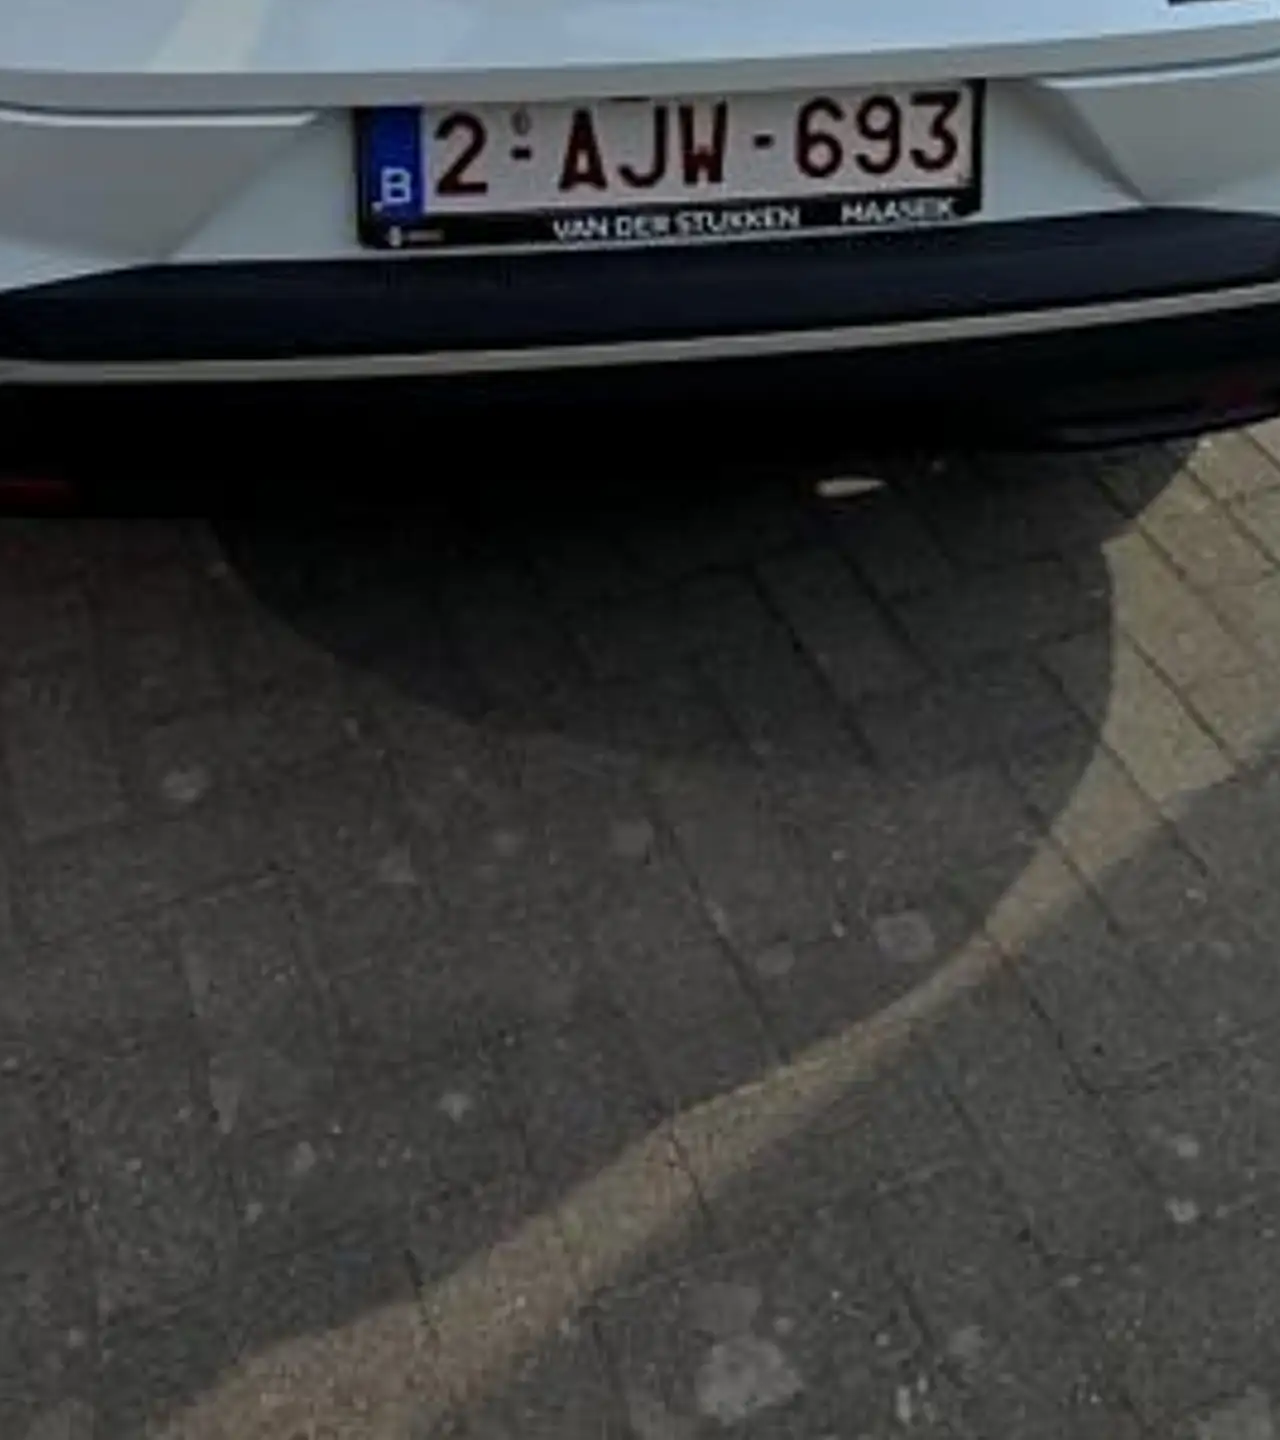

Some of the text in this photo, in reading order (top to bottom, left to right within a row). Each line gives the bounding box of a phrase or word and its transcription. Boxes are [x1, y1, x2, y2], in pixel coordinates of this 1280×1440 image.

[433, 90, 961, 198] 2-AJW-693
[380, 165, 412, 205] B
[552, 215, 608, 240] VAN
[615, 213, 670, 238] DER
[674, 205, 801, 236] STUKKEN
